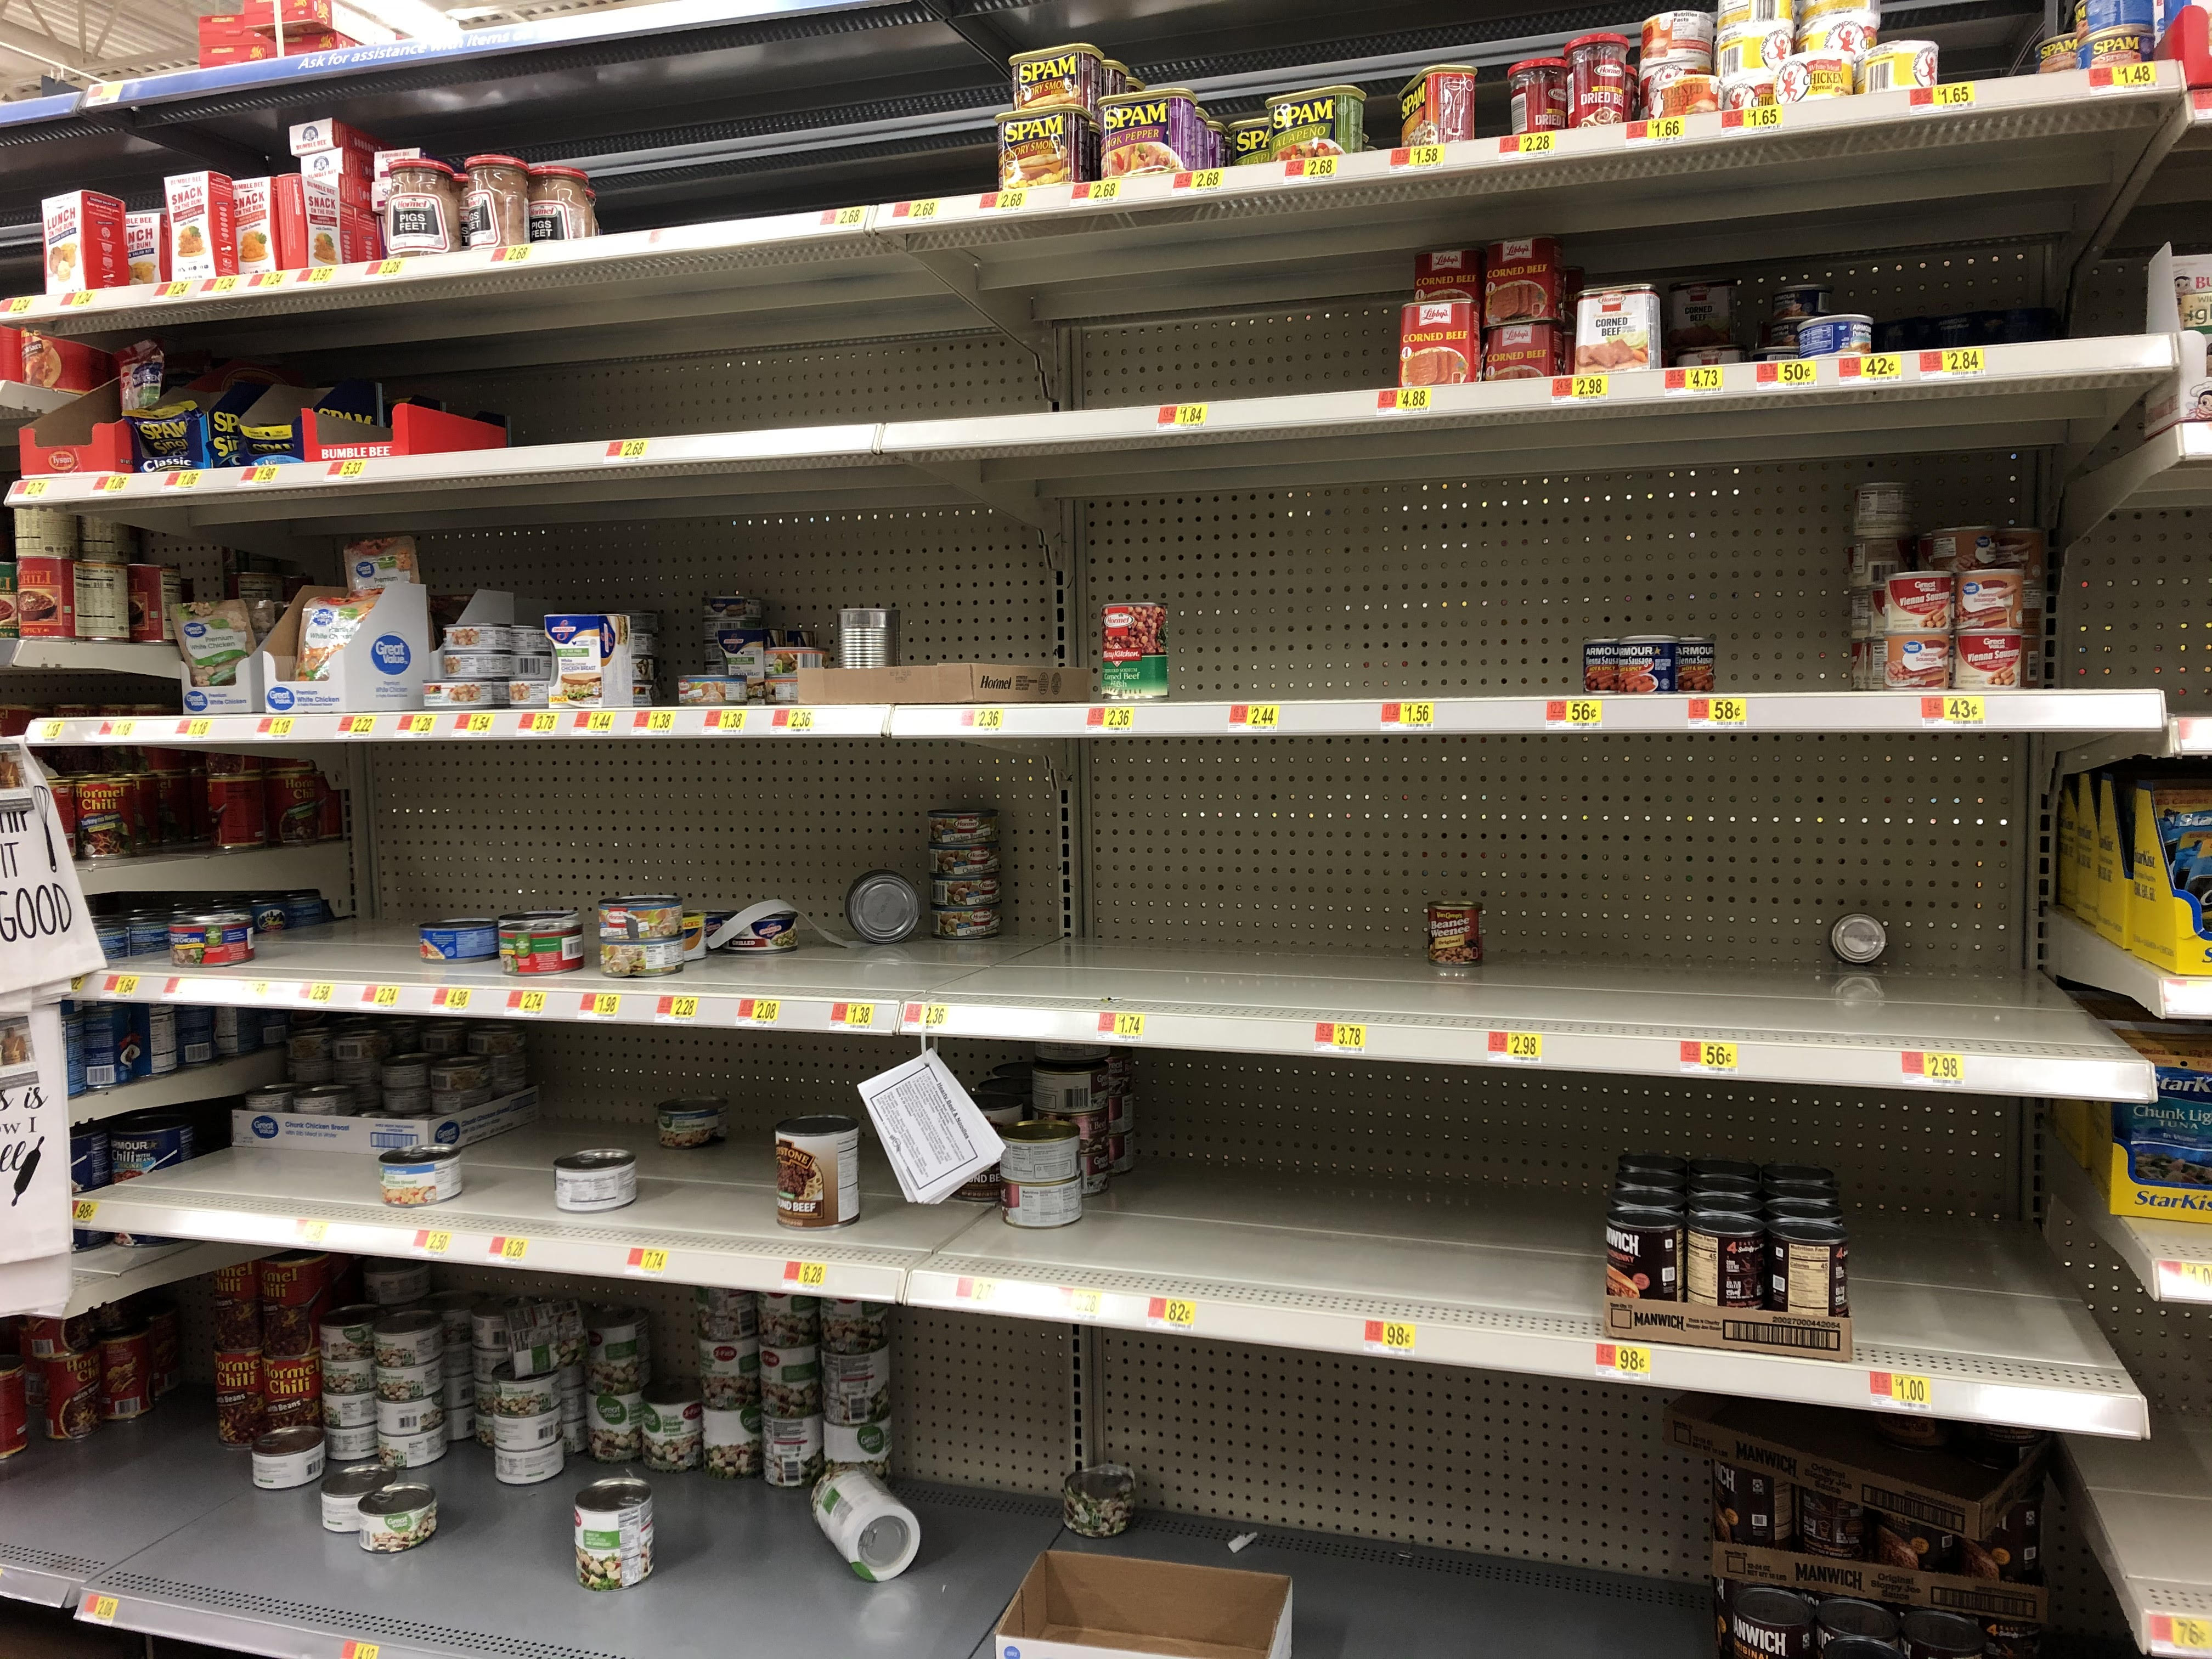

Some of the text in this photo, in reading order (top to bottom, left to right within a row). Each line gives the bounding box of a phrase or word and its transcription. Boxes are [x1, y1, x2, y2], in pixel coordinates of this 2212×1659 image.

[298, 55, 326, 70] Ask
[328, 53, 348, 66] for
[351, 42, 427, 63] assistance
[467, 30, 510, 47] items
[2041, 38, 2078, 59] SPAM
[2094, 36, 2140, 55] SPAM
[1019, 55, 1076, 83] SPAM
[2118, 65, 2151, 84] $1.48
[1803, 72, 1844, 86] CHICKEN
[1401, 82, 1426, 120] SPAM
[1581, 92, 1611, 105] DRIED
[1938, 86, 1969, 104] $1.65
[1103, 101, 1167, 129] SPAM
[1273, 99, 1334, 128] SPAM
[1536, 114, 1561, 126] DRIED
[1748, 109, 1777, 127] $1.65
[1005, 115, 1064, 142] SPAM
[1125, 128, 1160, 141] PEPPER
[1272, 124, 1326, 149] JALAPEÑO
[1651, 120, 1680, 138] $1.66
[1523, 134, 1550, 153] $2.28
[1413, 148, 1438, 163] $1.58
[1308, 159, 1333, 176] $2.68
[1196, 172, 1219, 188] $2.68
[171, 186, 203, 206] SNACK
[1093, 183, 1116, 198] $2.68
[233, 191, 266, 211] SNACK
[308, 195, 336, 210] SNACK
[397, 199, 428, 210] Hormel
[914, 201, 934, 217] $2.68
[47, 208, 76, 230] LUNCH
[399, 213, 426, 223] PIGS
[839, 208, 861, 224] 2.68
[399, 221, 428, 232] FEET
[531, 220, 552, 230] PIGS
[531, 228, 554, 238] FEET
[509, 247, 528, 261] 2.68
[1487, 263, 1548, 279] CORNED BEEF
[1416, 274, 1477, 287] CORNED BEEF
[1421, 308, 1449, 323] Libby's
[1684, 305, 1713, 315] CORNED
[1689, 313, 1707, 322] BEEF
[1595, 317, 1628, 328] CORNED
[1402, 330, 1468, 343] CORNED BEEF
[1505, 329, 1530, 341] Libby's
[1601, 326, 1622, 337] BEEF
[1487, 349, 1547, 363] CORNED BEEF
[1947, 351, 1979, 370] $2.84
[1784, 363, 1811, 381] 50¢
[1866, 358, 1895, 376] 42¢
[1690, 369, 1718, 387] $4.73
[1576, 379, 1602, 396] $2.98
[1401, 391, 1426, 407] $4.88
[1180, 406, 1203, 425] $1.84
[140, 421, 187, 441] SPAM
[321, 445, 391, 460] BUMBLE BEE
[143, 456, 192, 473] Classic
[343, 461, 363, 475] 5.33
[1914, 580, 1936, 589] Great
[1900, 594, 1925, 605] Vienna
[1107, 616, 1130, 625] Hormel
[205, 635, 234, 644] Premium
[208, 642, 235, 650] Chicken
[1983, 637, 2005, 646] Great
[375, 641, 405, 657] Great
[1114, 650, 1138, 659] Kitchen
[1967, 649, 2019, 662] Vienna Sausage
[382, 654, 405, 665] Value
[1628, 657, 1653, 667] Sausage
[980, 675, 1012, 690] Hormel
[1103, 672, 1141, 681] Corned Beef
[1251, 708, 1274, 725] $2.44
[1404, 706, 1429, 722] $1.56
[1571, 703, 1596, 721] 56¢
[1714, 701, 1741, 720] 58¢
[1950, 700, 1978, 718] 43¢
[471, 716, 488, 731] 1.54
[723, 712, 742, 729] $1.38
[792, 712, 811, 727] $2.36
[979, 710, 999, 726] $2.36
[1108, 709, 1129, 726] $2.36
[191, 721, 208, 736] 1.18
[76, 786, 125, 800] Hormel
[81, 799, 117, 811] Chili
[956, 820, 978, 829] Hormel
[949, 834, 969, 842] Chicken
[1430, 917, 1470, 930] Beanee
[1430, 925, 1470, 938] Weenee
[449, 991, 469, 1007] 4.98
[523, 994, 543, 1010] 2.74
[597, 996, 617, 1013] 1.98
[674, 1000, 695, 1015] $2.28
[757, 1001, 776, 1019] $2.08
[850, 1006, 870, 1024] $1.38
[1118, 1015, 1140, 1035] $1.74
[1337, 1026, 1361, 1046] $3.78
[1511, 1035, 1537, 1055] $2.98
[1706, 1046, 1731, 1065] 56¢
[1928, 1056, 1958, 1078] $2.98
[24, 1087, 48, 1109] is
[937, 1082, 948, 1101] Hearty
[946, 1099, 956, 1114] Beef
[957, 1117, 970, 1140] Noodles
[2133, 1105, 2212, 1123] Chunk Lig
[253, 1120, 276, 1131] Great
[304, 1122, 329, 1130] Chicken
[2159, 1120, 2199, 1130] TUNA
[2171, 1133, 2197, 1143] Water
[112, 1150, 135, 1163] Chili
[793, 1201, 816, 1212] BEEF
[2134, 1190, 2212, 1212] StarKis
[1168, 1304, 1190, 1322] 82¢
[1634, 1312, 1685, 1330] MANWICH
[1773, 1316, 1841, 1329] 20027000442054
[1387, 1327, 1410, 1346] 98¢
[1620, 1350, 1645, 1371] 98¢
[263, 1360, 320, 1380] Hormel
[217, 1371, 256, 1387] Chili
[269, 1377, 311, 1395] Chili
[1895, 1377, 1925, 1402] $1.00
[224, 1393, 246, 1403] Beans
[278, 1399, 302, 1412] Beans
[599, 1405, 620, 1414] Great
[1735, 1441, 1798, 1476] MANWICH
[1811, 1462, 1846, 1480] Original
[387, 1516, 409, 1526] Great
[1795, 1562, 1864, 1592] MANWICH
[1877, 1572, 1914, 1585] Original
[1870, 1579, 1921, 1594] Sloppy Joe
[1882, 1589, 1910, 1601] Sauce
[1732, 1616, 1787, 1657] ANWICH
